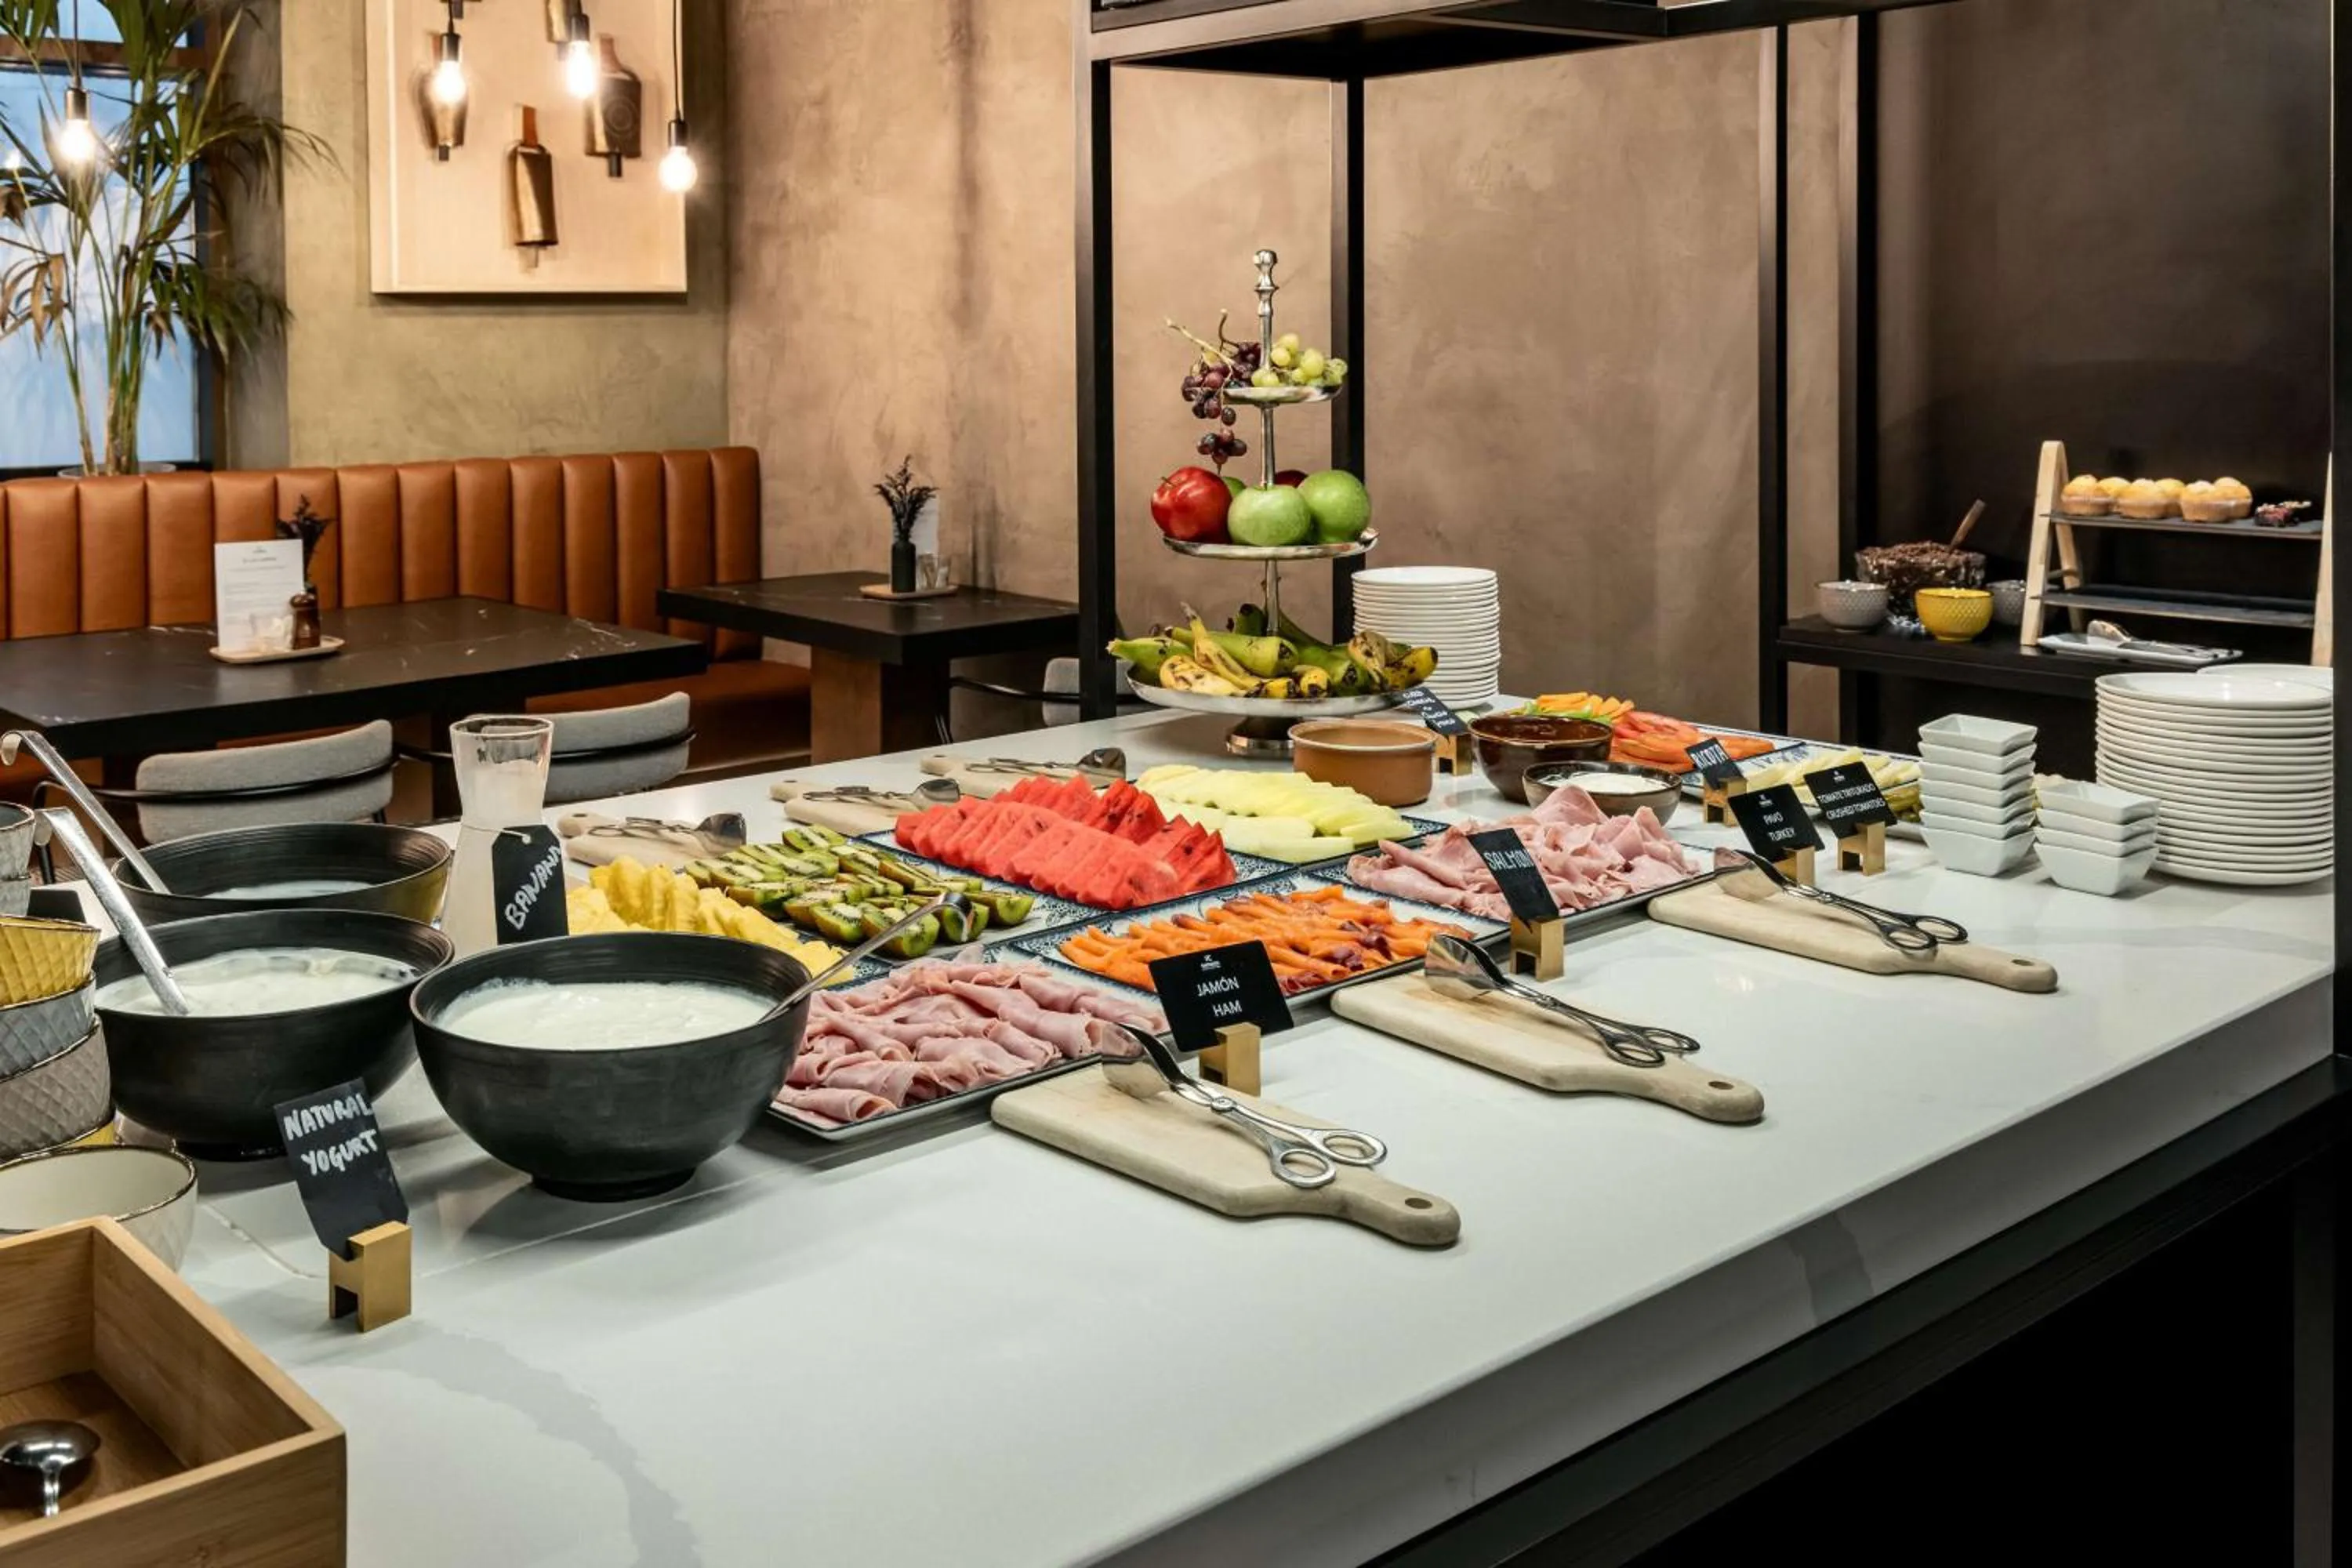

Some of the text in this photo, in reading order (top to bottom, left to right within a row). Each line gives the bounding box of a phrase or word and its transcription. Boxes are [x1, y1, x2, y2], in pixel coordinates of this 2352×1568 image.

[1817, 789, 1845, 804] TOMATE
[1763, 811, 1784, 825] PAVO
[1826, 797, 1886, 820] CRUSHED TOMATOES
[1768, 826, 1795, 841] TURKEY
[505, 845, 561, 931] BANANA
[1196, 976, 1240, 997] JAMÓN
[1213, 1000, 1243, 1017] HAM
[283, 1093, 374, 1141] NATURAL
[300, 1128, 378, 1176] YOGURT
